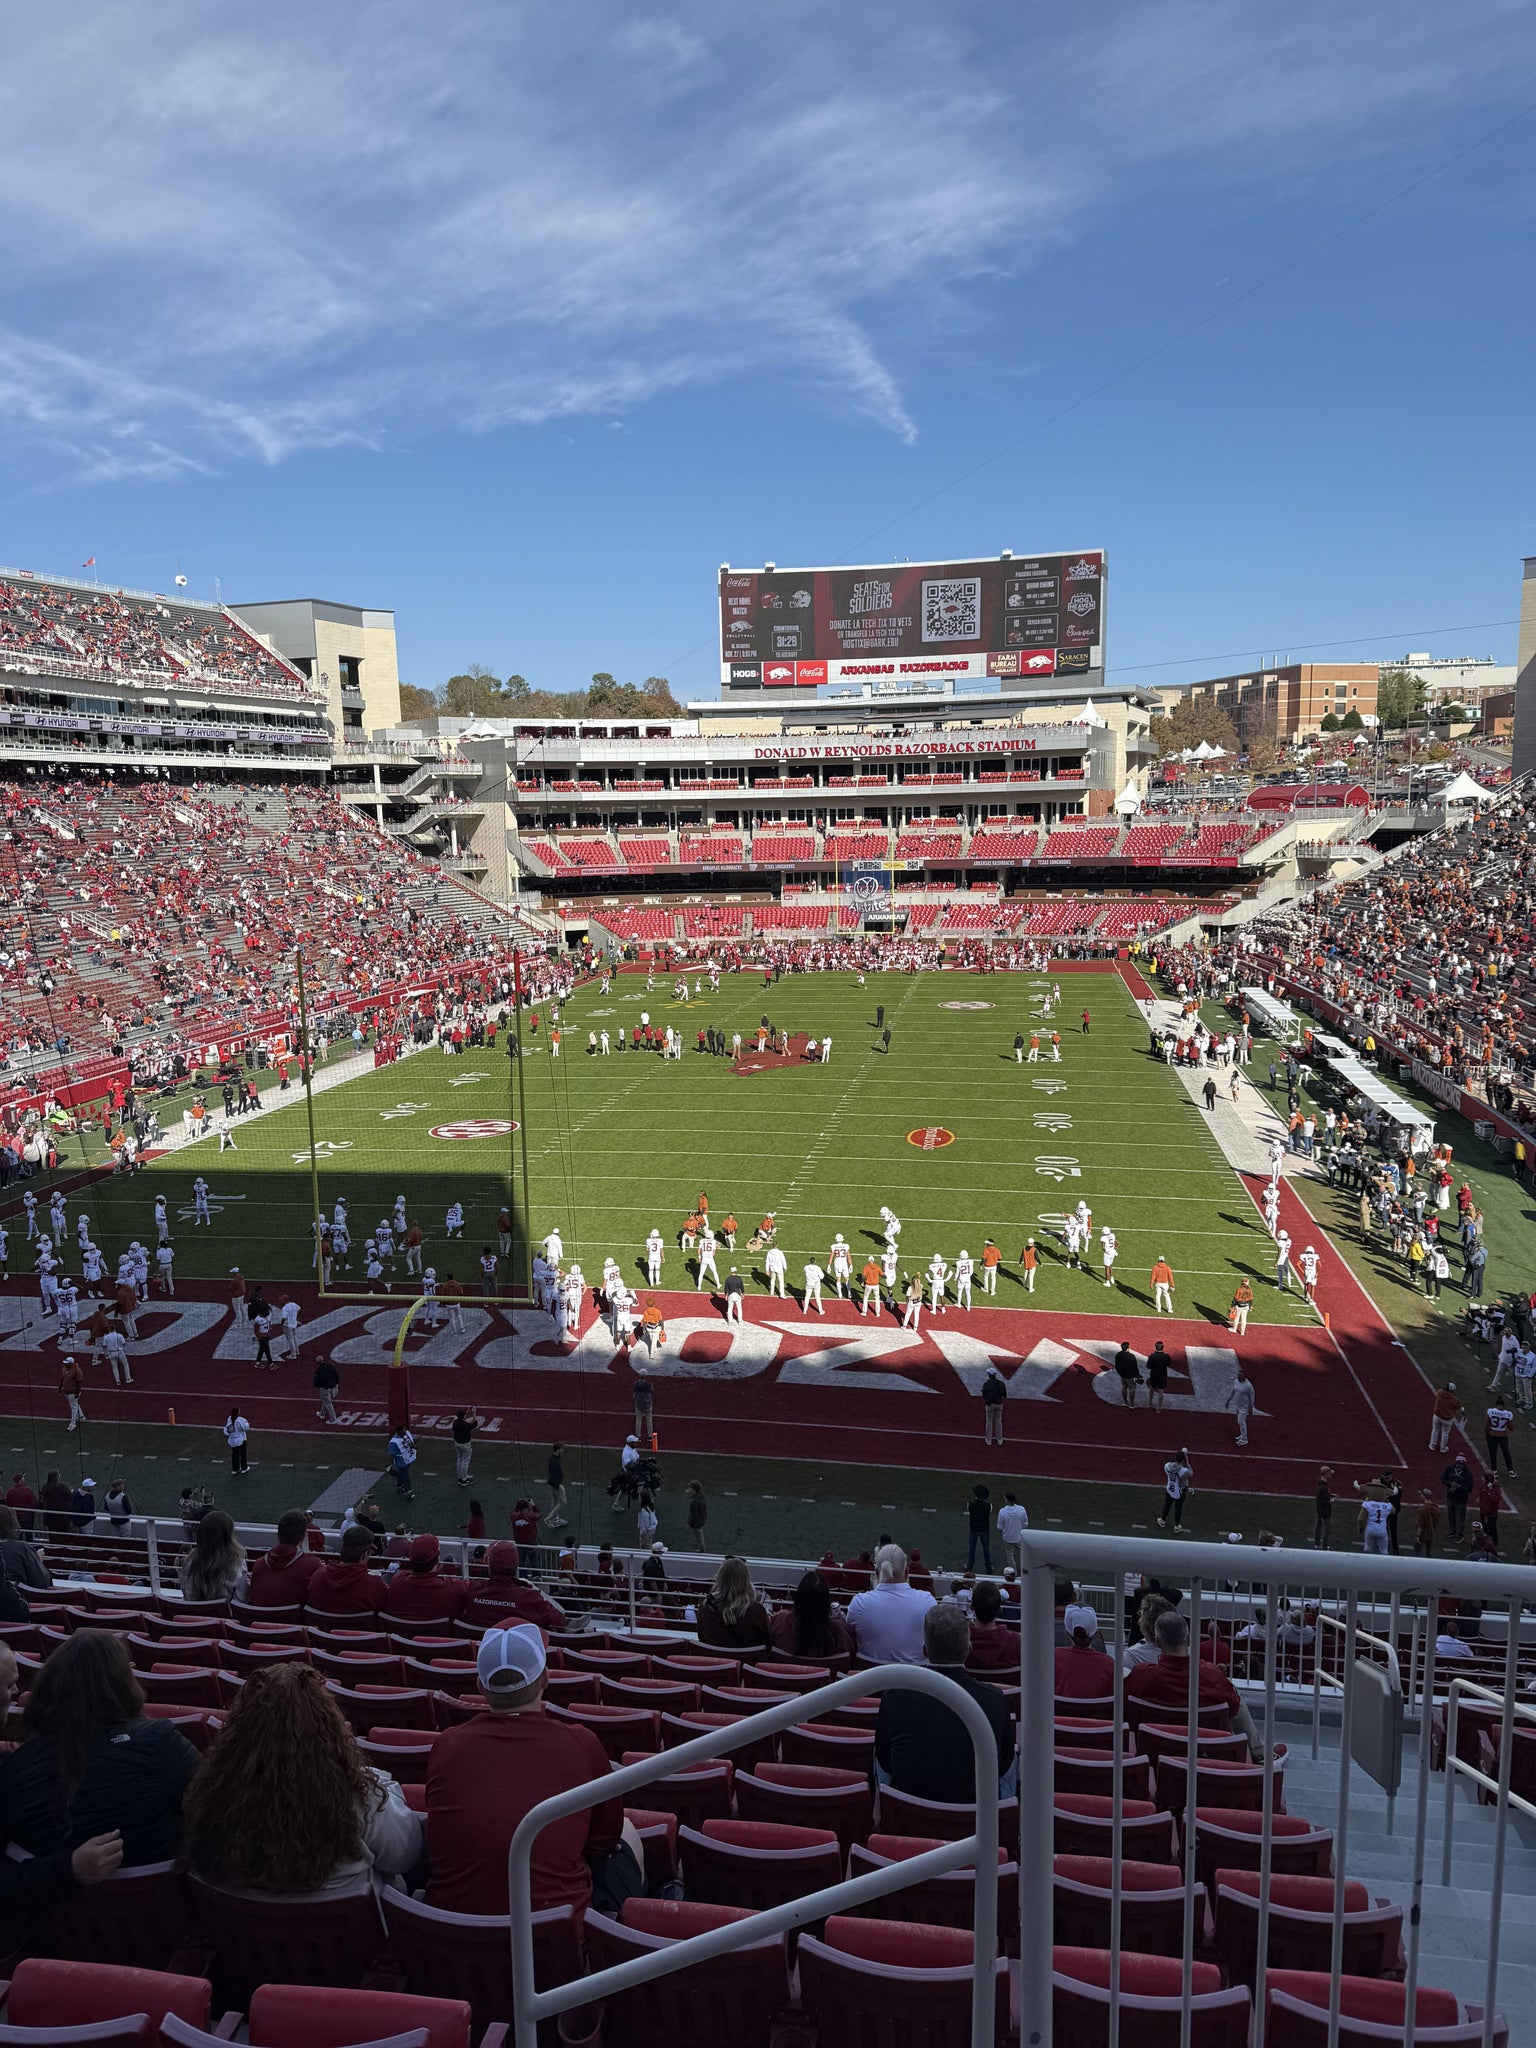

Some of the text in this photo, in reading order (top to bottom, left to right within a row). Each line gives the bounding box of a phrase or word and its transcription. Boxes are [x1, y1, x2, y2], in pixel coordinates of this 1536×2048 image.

[854, 580, 891, 598] SEATS FOR
[849, 592, 892, 614] SOLDIERS
[1069, 602, 1094, 610] HEAVEN
[830, 616, 912, 630] DONATE LA TECH TIX TO VETS
[838, 630, 844, 638] OR
[845, 630, 868, 638] TRANSFER
[776, 636, 797, 648] 31:29
[1058, 652, 1089, 662] SARACEN
[840, 660, 970, 676] ARKANSAS RAZORBACKS
[990, 660, 1017, 668] BUREAU
[48, 718, 79, 728] HYUNDAI
[122, 724, 150, 734] HYUNDAI
[197, 730, 227, 738] HYUNDAI
[268, 733, 294, 742] HYUNDAI
[754, 738, 1037, 758] DONALD W REYNOLDS RAZORBACK STADIUM
[848, 900, 886, 912] Allstate
[1412, 1061, 1460, 1107] RAZORBACKS
[1032, 1112, 1074, 1129] 30
[1034, 1156, 1082, 1177] 20
[1070, 1226, 1076, 1236] 7
[378, 1232, 388, 1242] 16
[651, 1242, 658, 1252] 3
[702, 1242, 712, 1252] 16
[834, 1249, 846, 1258] 83
[486, 1260, 493, 1270] 2
[1304, 1257, 1315, 1267] 13
[936, 1268, 942, 1278] 4
[960, 1264, 971, 1275] 21
[567, 1279, 580, 1289] 15
[616, 1304, 630, 1312] 26
[336, 1411, 504, 1433] TGEHER
[1490, 1416, 1510, 1432] 37
[1375, 1509, 1382, 1524] 1
